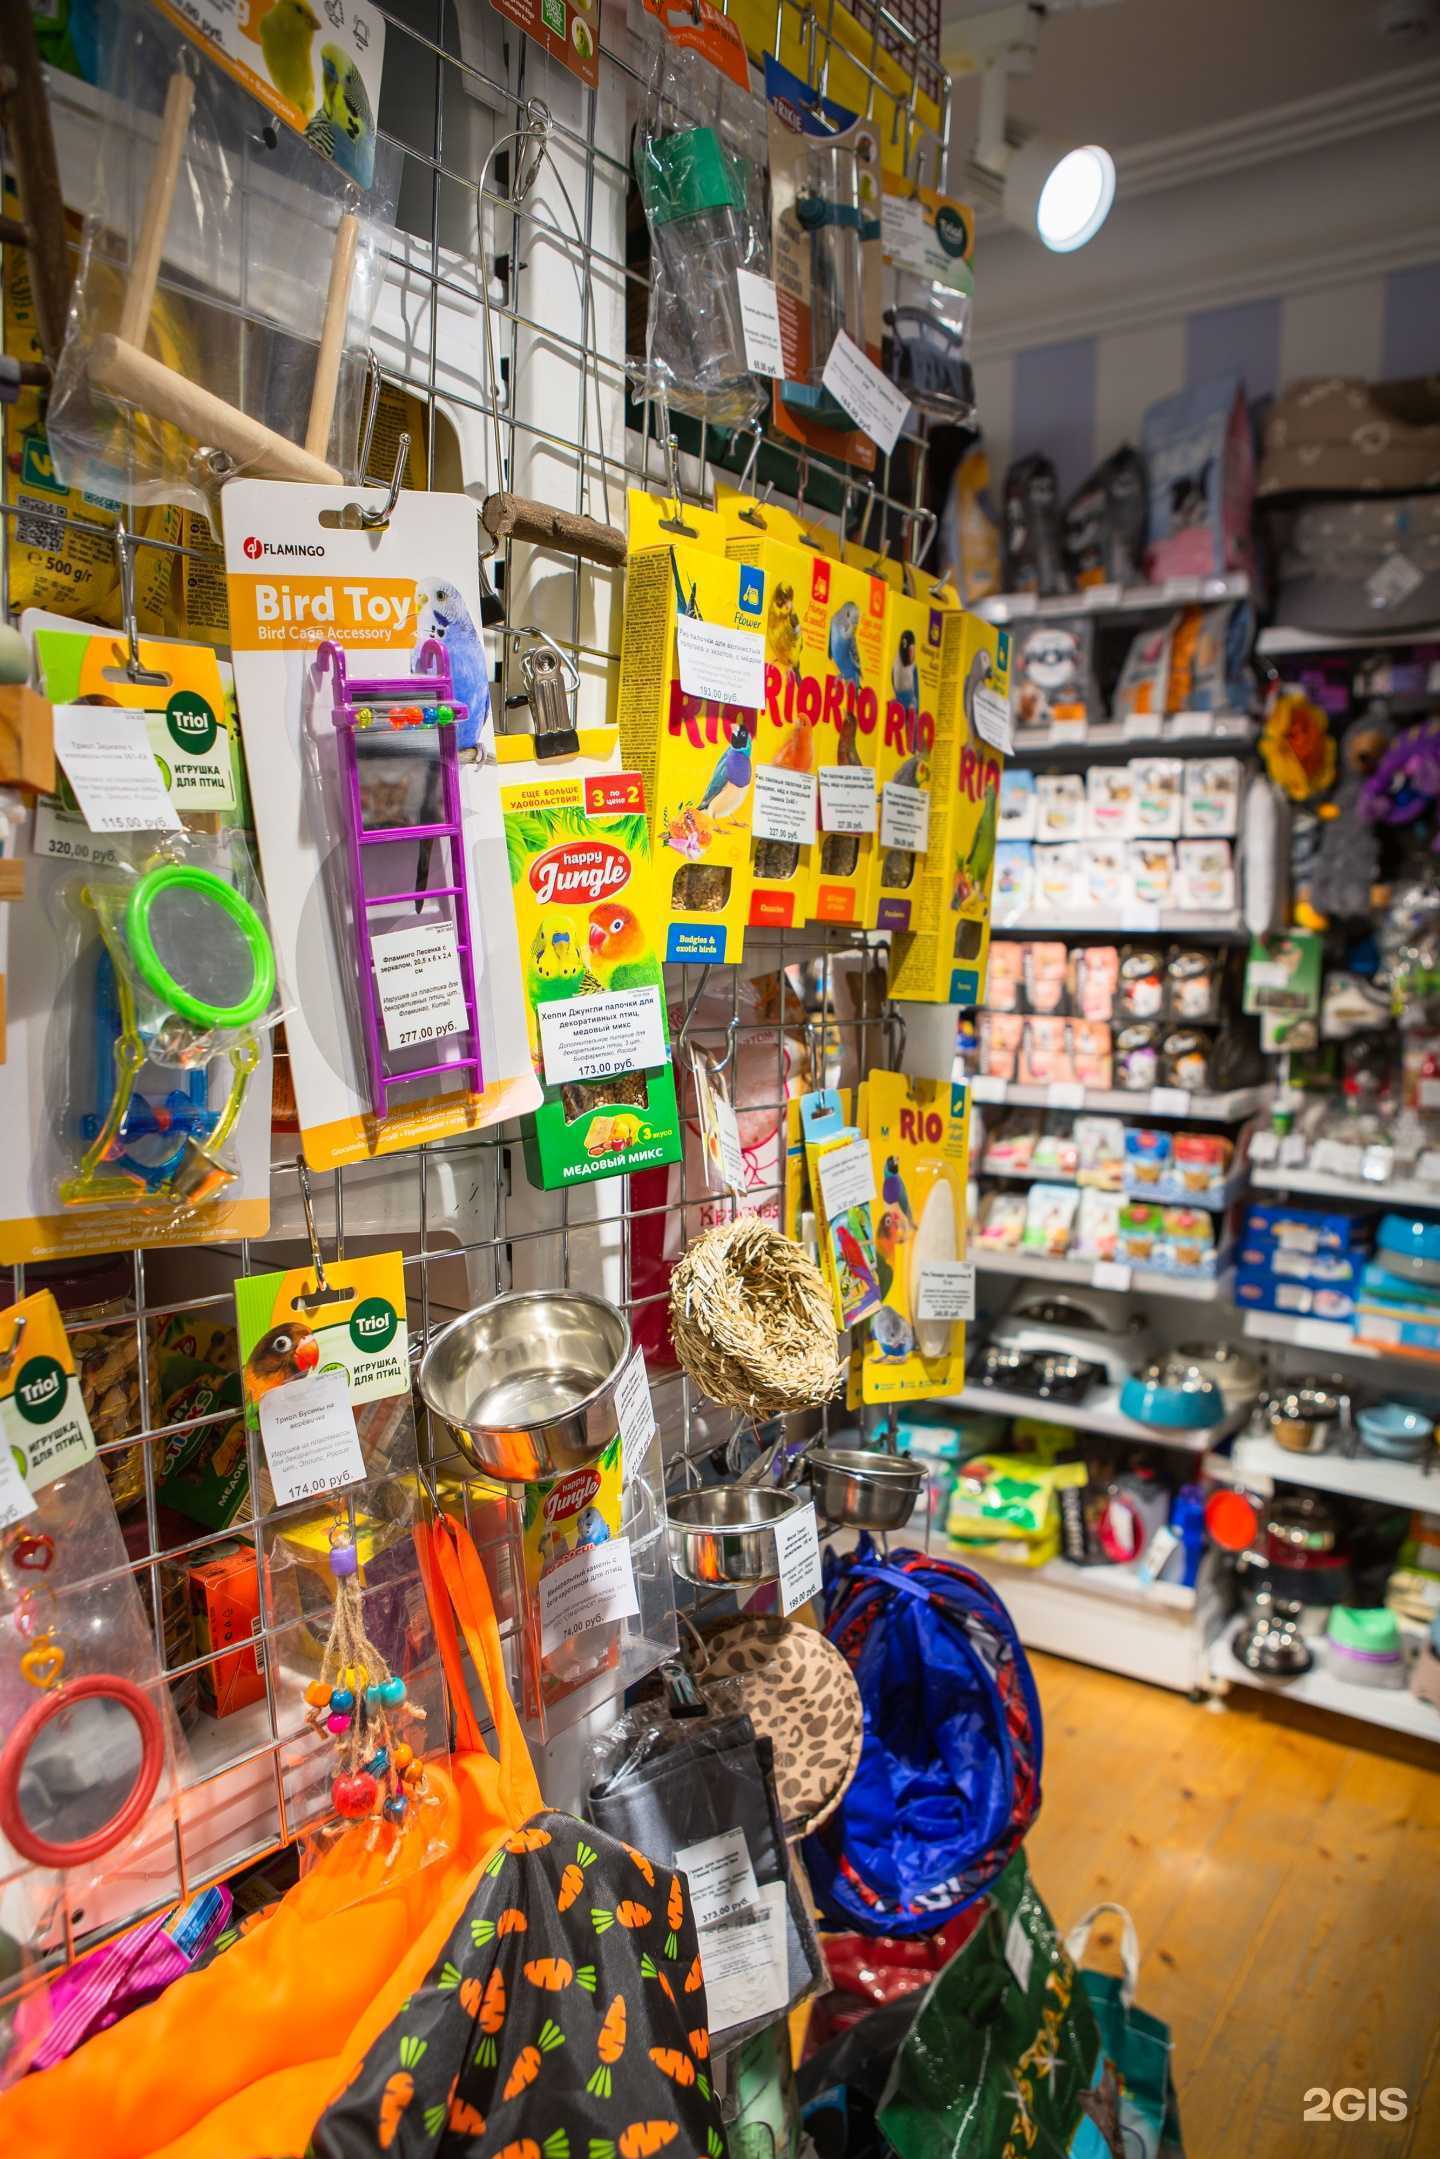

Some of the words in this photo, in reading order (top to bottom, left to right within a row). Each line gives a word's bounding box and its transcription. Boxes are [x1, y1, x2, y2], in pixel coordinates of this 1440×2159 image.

[263, 543, 325, 557] FLAMINGO
[45, 557, 72, 577] 500
[255, 584, 335, 622] Bird
[343, 586, 412, 630] Toy
[734, 611, 762, 630] Flower
[258, 625, 286, 640] Bird
[289, 626, 324, 643] Cage
[327, 628, 392, 643] Accessory
[761, 662, 822, 728] RIO
[823, 674, 878, 735] RIO
[172, 711, 209, 729] Triol
[884, 700, 936, 757] RIO
[174, 764, 220, 776] ИГРУШКА
[176, 777, 197, 788] ДЛЯ
[199, 777, 225, 790] ПТИЦ
[544, 786, 579, 797] БОЛЬШЕ
[510, 795, 580, 809] УДОВОЛЬСТВИЯ!
[592, 789, 605, 807] 3
[606, 797, 626, 806] цене
[626, 786, 640, 804] 2
[49, 839, 90, 858] 320,00
[563, 851, 602, 866] happy
[536, 856, 627, 905] Jungle
[676, 945, 698, 953] exotic
[698, 945, 717, 954] birds
[679, 934, 707, 946] Budgies
[709, 936, 716, 944] &
[383, 950, 415, 963] Фламинго
[417, 946, 441, 957] Лесенка
[381, 961, 413, 974] зеркалом,
[541, 1010, 567, 1021] Хеппи
[569, 1005, 603, 1018] Джунгли
[605, 1001, 638, 1011] палочки
[639, 997, 655, 1006] для
[559, 1014, 617, 1030] декоративных
[573, 1025, 610, 1037] медовый
[612, 1021, 631, 1031] микс
[400, 1026, 433, 1045] 277,00
[436, 1020, 458, 1035] руб.
[578, 1061, 611, 1076] 173,00
[614, 1058, 635, 1072] руб.
[642, 1128, 652, 1140] 3
[652, 1128, 673, 1140] вкуса
[900, 1108, 943, 1145] RIO
[563, 1153, 626, 1178] МЕДОВЫЙ
[628, 1147, 664, 1164] МИКС
[356, 1312, 389, 1333] Triol
[353, 1357, 398, 1375] ИГРУШКА
[354, 1373, 374, 1387] ДЛЯ
[376, 1365, 402, 1382] ПТИЦ
[20, 1371, 59, 1402] Triol
[28, 1421, 77, 1453] ИГРУШКА
[32, 1449, 53, 1468] ДЛЯ
[55, 1432, 83, 1453] ПТИЦ
[288, 1476, 326, 1500] 174,00
[329, 1470, 353, 1488] руб.
[562, 1474, 586, 1494] happy
[545, 1476, 599, 1522] Jungle
[585, 1612, 605, 1630] руб.
